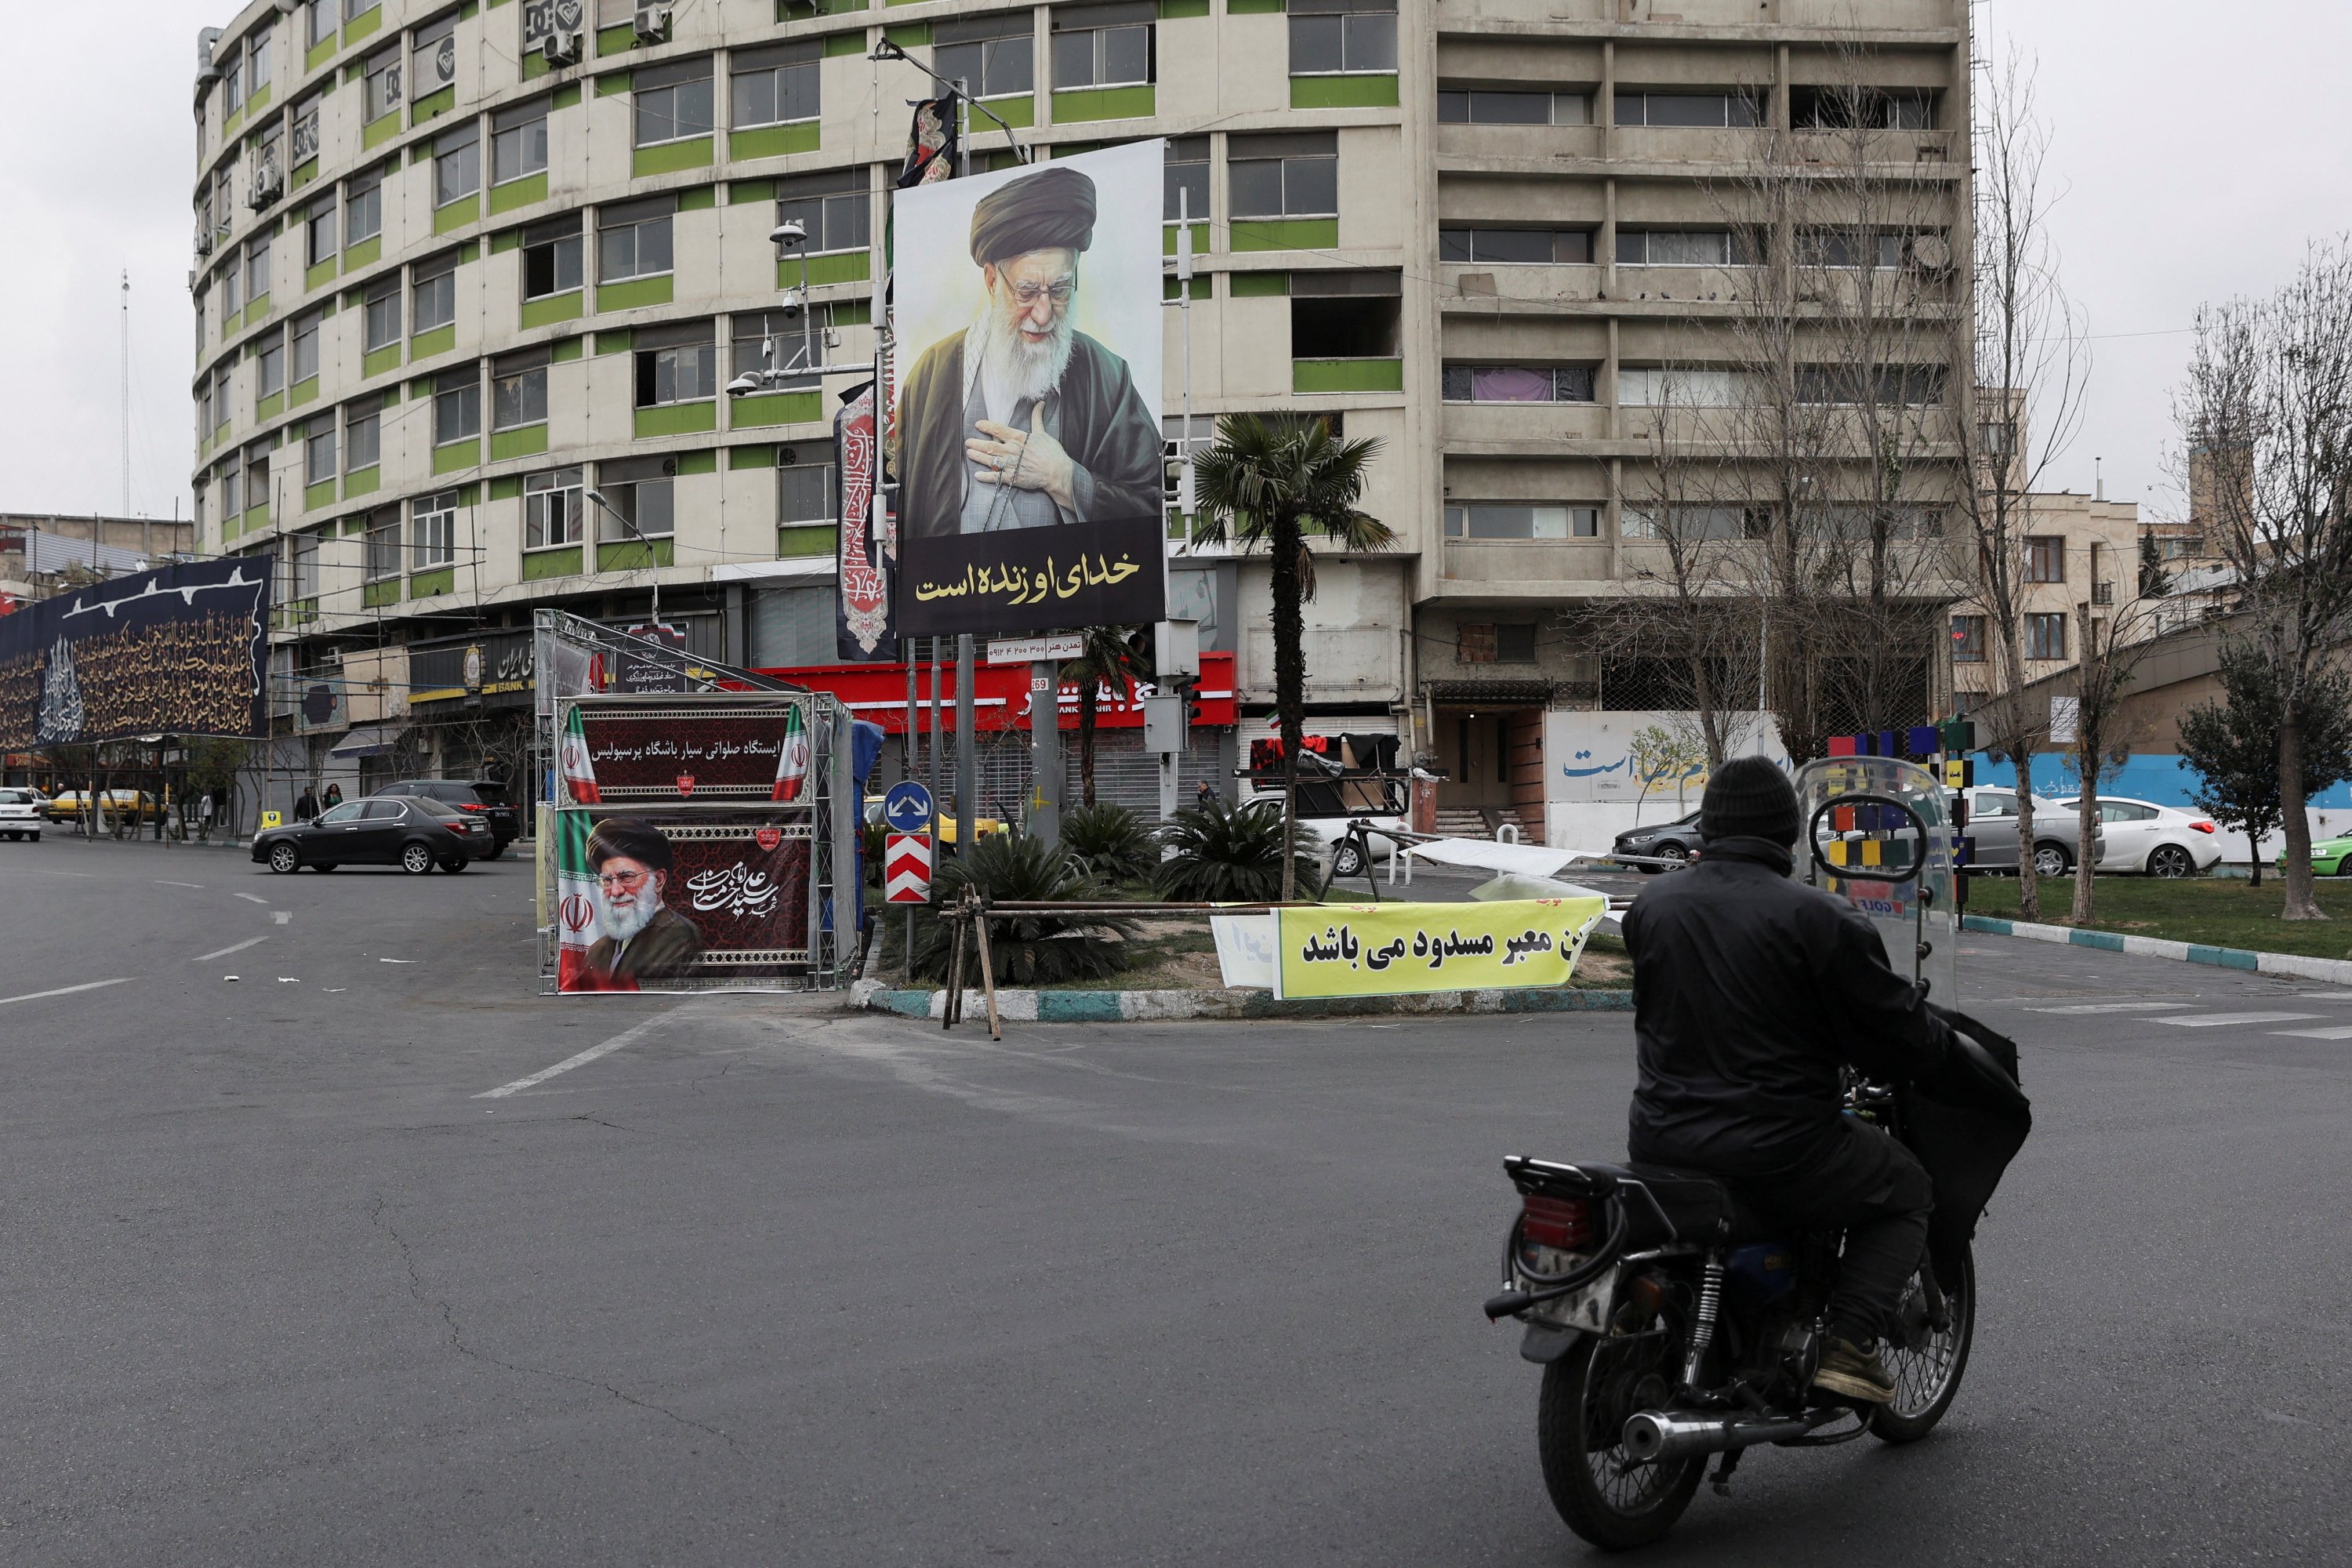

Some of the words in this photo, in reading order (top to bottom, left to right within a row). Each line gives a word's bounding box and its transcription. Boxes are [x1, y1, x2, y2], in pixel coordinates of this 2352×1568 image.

[915, 562, 975, 601] است
[978, 562, 1029, 604] زنده
[1026, 555, 1054, 603] او
[1057, 553, 1140, 598] خدای
[989, 648, 1004, 657] ۰۹۱۲
[1047, 643, 1062, 653] هنر
[1062, 641, 1081, 652] تمدن
[498, 648, 524, 680] ایران
[499, 681, 524, 692] BANK
[591, 742, 642, 762] پرسپولیس
[645, 740, 677, 759] باشگاه
[681, 744, 702, 760] سیار
[705, 742, 740, 760] صلواتی
[743, 740, 780, 756] ایستگاه
[1563, 750, 1634, 777] است
[743, 872, 773, 897] علی
[747, 895, 777, 918] شهید
[1302, 924, 1359, 970] باشد
[1366, 935, 1406, 971] می
[1413, 927, 1494, 969] مسدود
[1503, 927, 1552, 965] معبر
